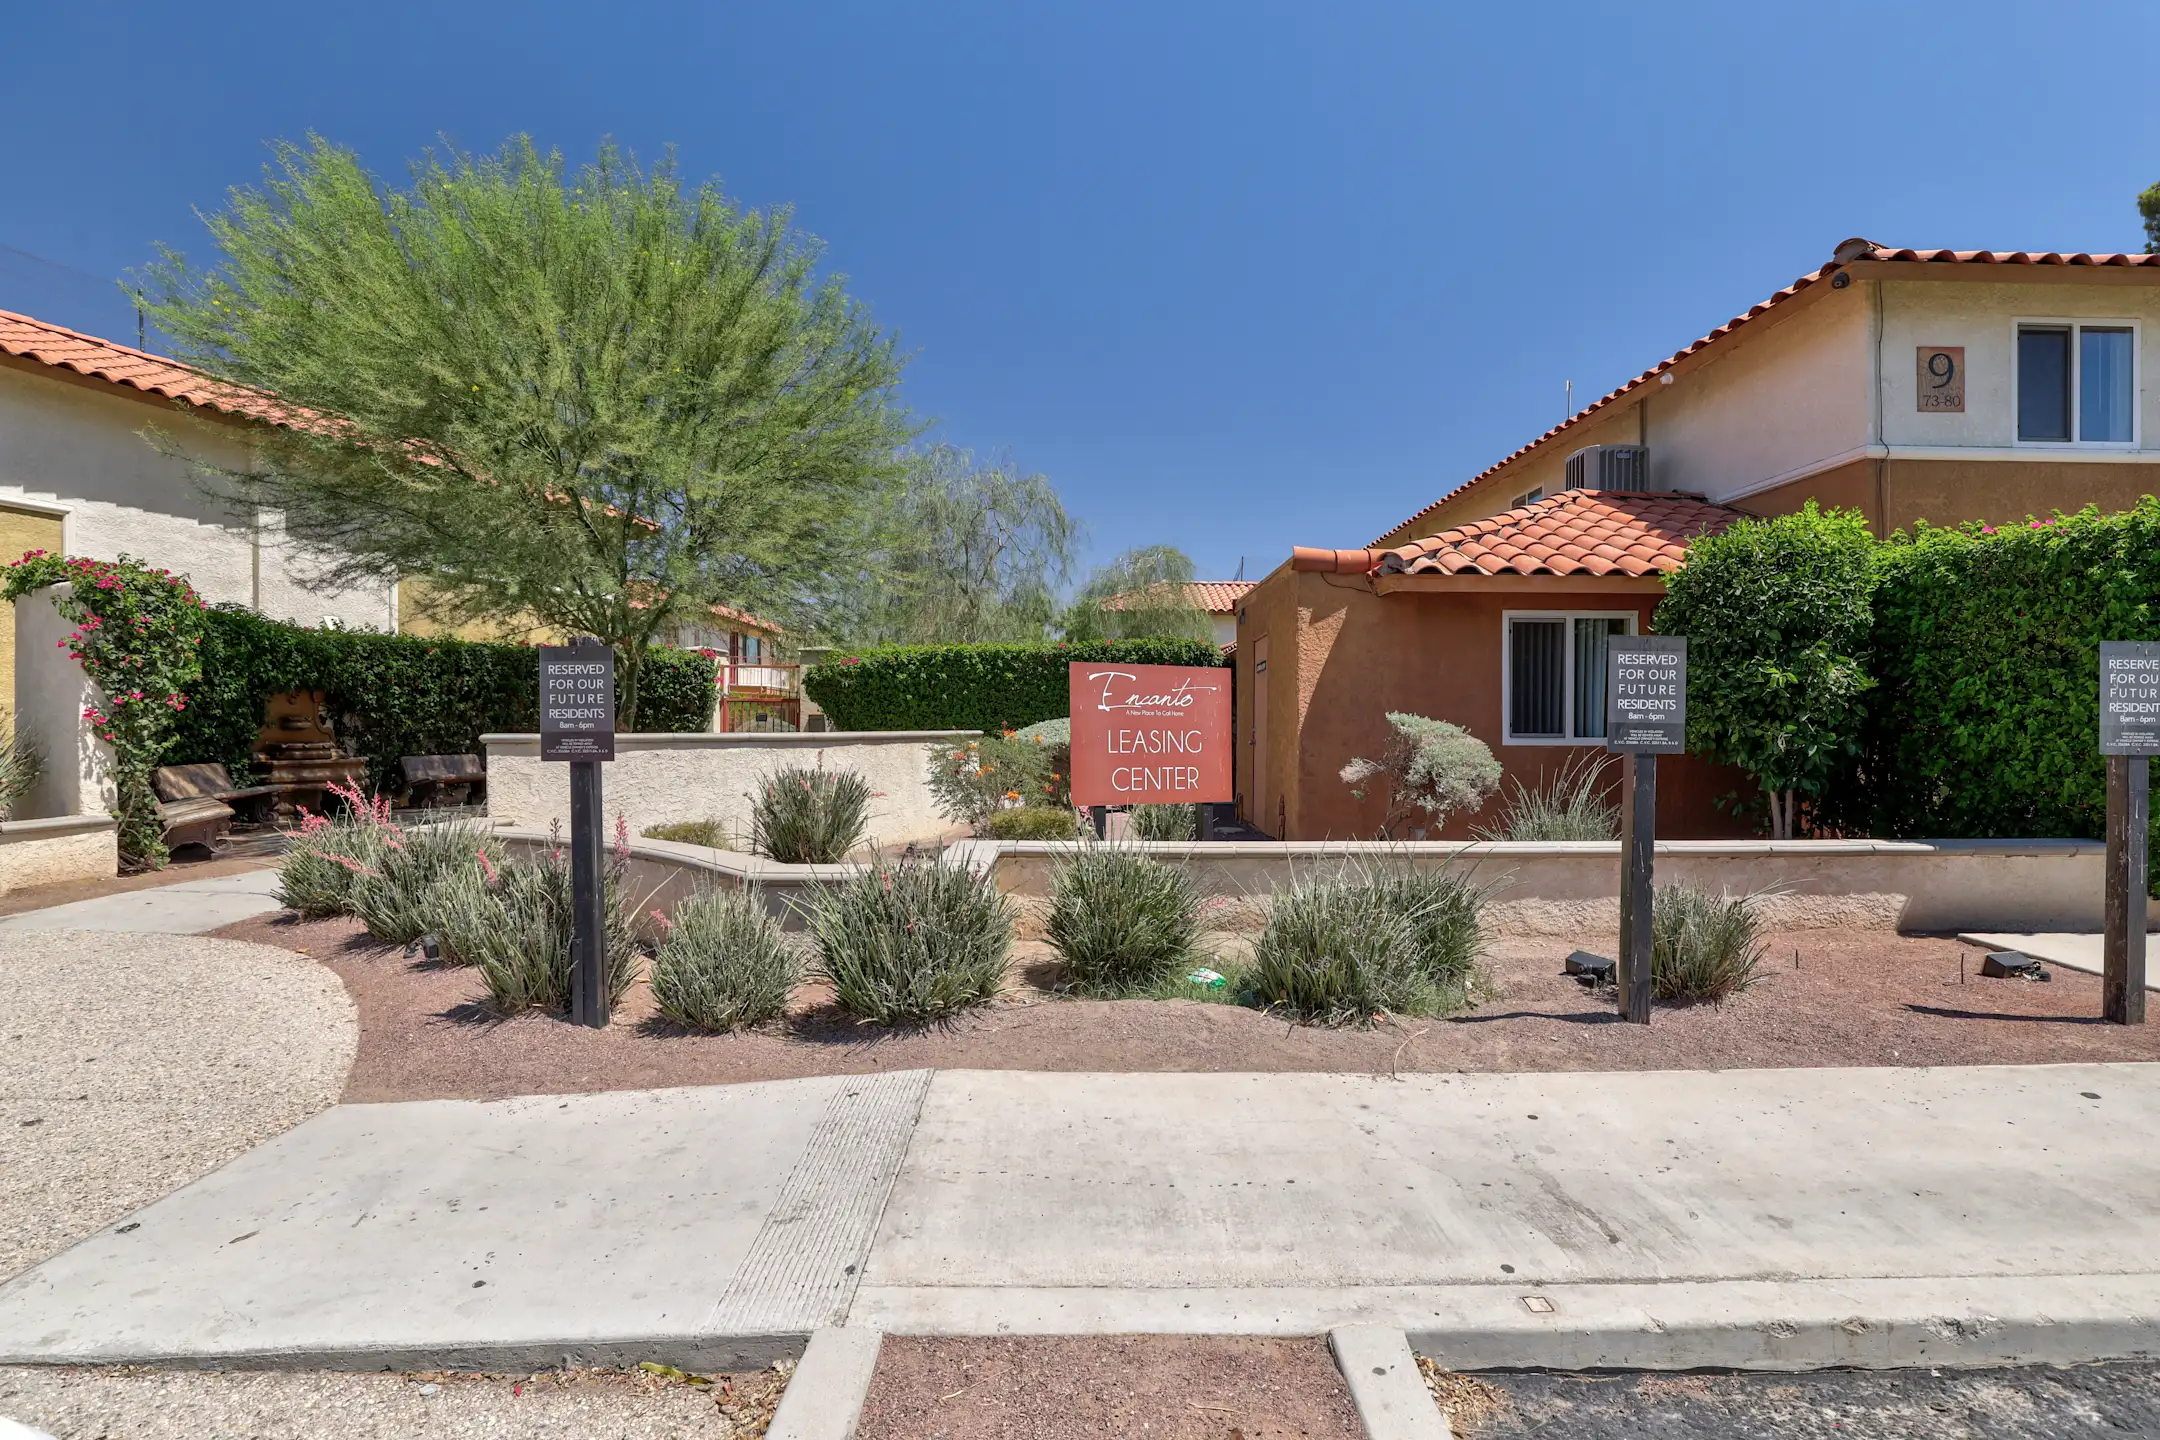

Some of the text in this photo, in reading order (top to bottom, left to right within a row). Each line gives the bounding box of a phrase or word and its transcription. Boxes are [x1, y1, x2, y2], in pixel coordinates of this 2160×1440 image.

[1928, 353, 1954, 389] 9
[1923, 395, 1961, 407] 73-80
[1617, 654, 1678, 665] RESERVED
[547, 664, 605, 675] RESERVED
[1618, 669, 1677, 680] FOR OUR
[2109, 673, 2136, 684] FOR
[549, 679, 604, 690] FOR OUR
[1618, 683, 1676, 695] FUTURE
[1088, 671, 1217, 712] Encanto
[549, 693, 605, 704] FUTURE
[1617, 698, 1677, 710] RESIDENTS
[548, 708, 605, 719] RESIDENTS
[1628, 711, 1644, 720] 8am
[1648, 712, 1665, 721] 6pm
[2119, 714, 2136, 723] 8am
[2139, 715, 2156, 725] 6pm
[559, 721, 575, 729] 8am
[578, 721, 595, 730] 6pm
[1107, 729, 1203, 754] LEASING
[1111, 766, 1200, 792] CENTER
